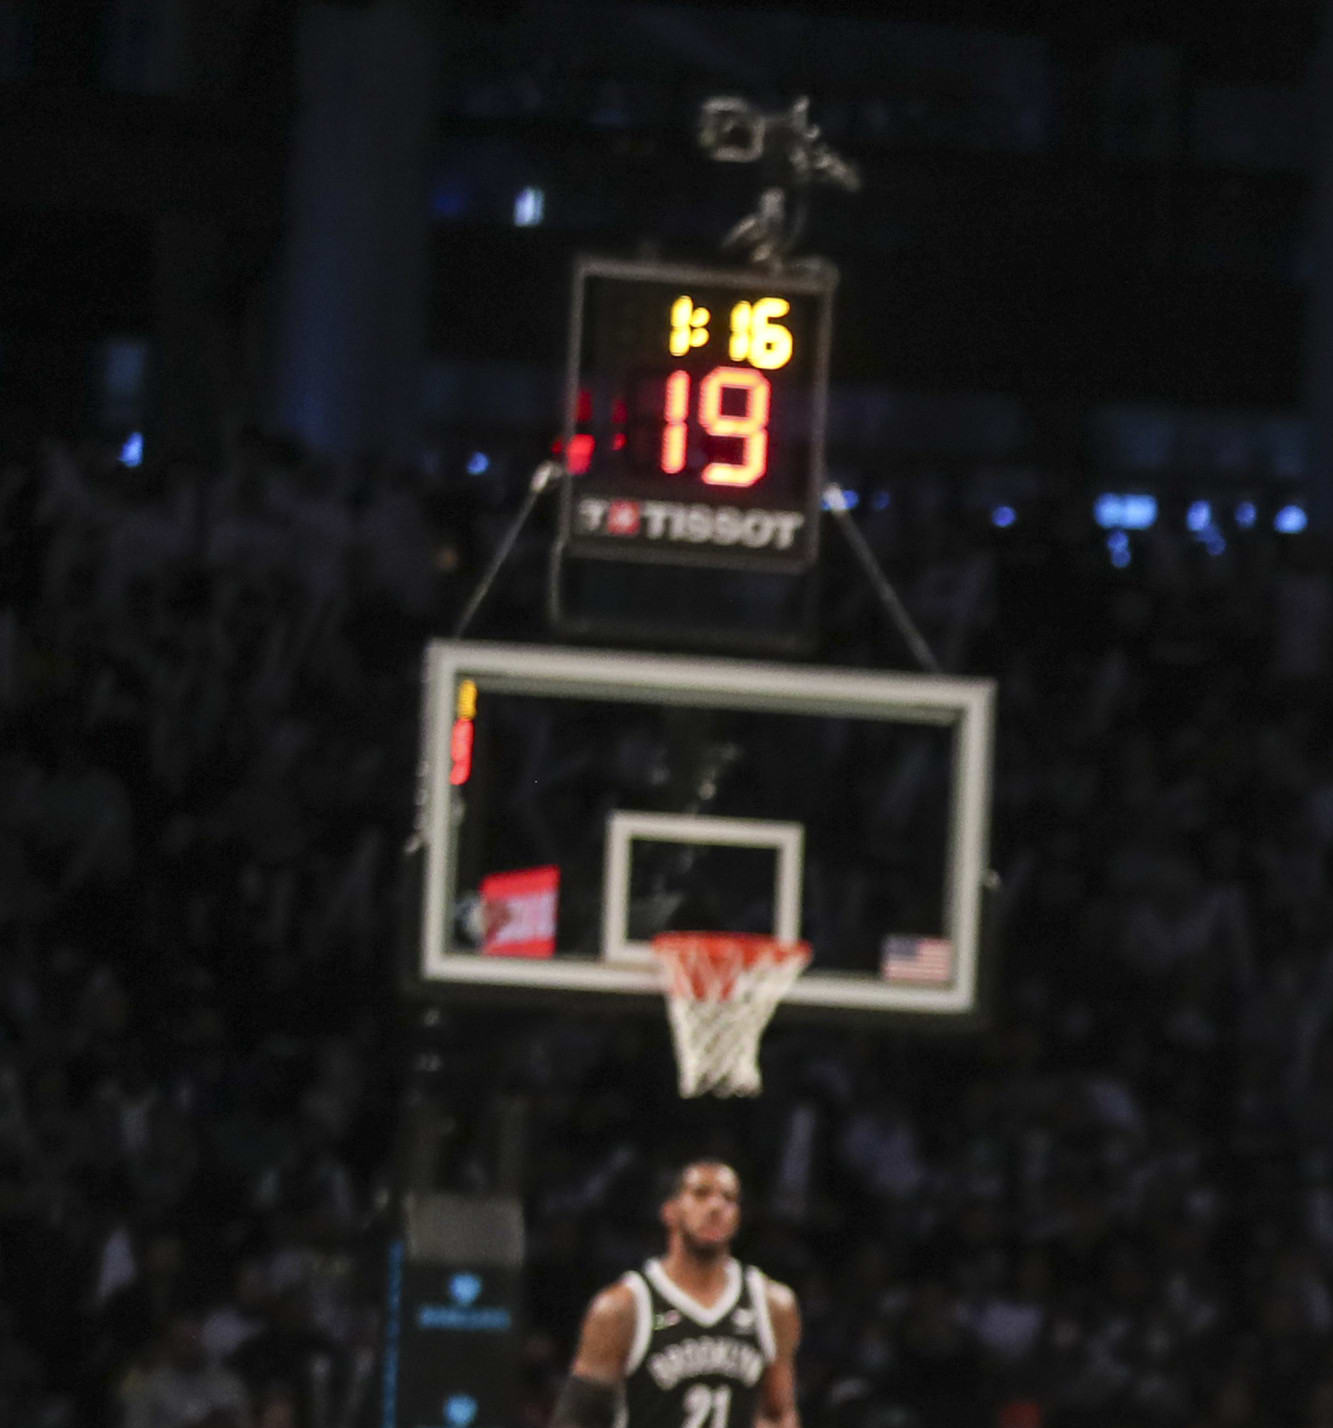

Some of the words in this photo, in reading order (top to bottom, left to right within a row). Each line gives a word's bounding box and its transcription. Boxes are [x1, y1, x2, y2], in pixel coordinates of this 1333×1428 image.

[669, 295, 794, 370] 1:16
[660, 366, 771, 488] 19
[648, 503, 804, 549] TISSOT
